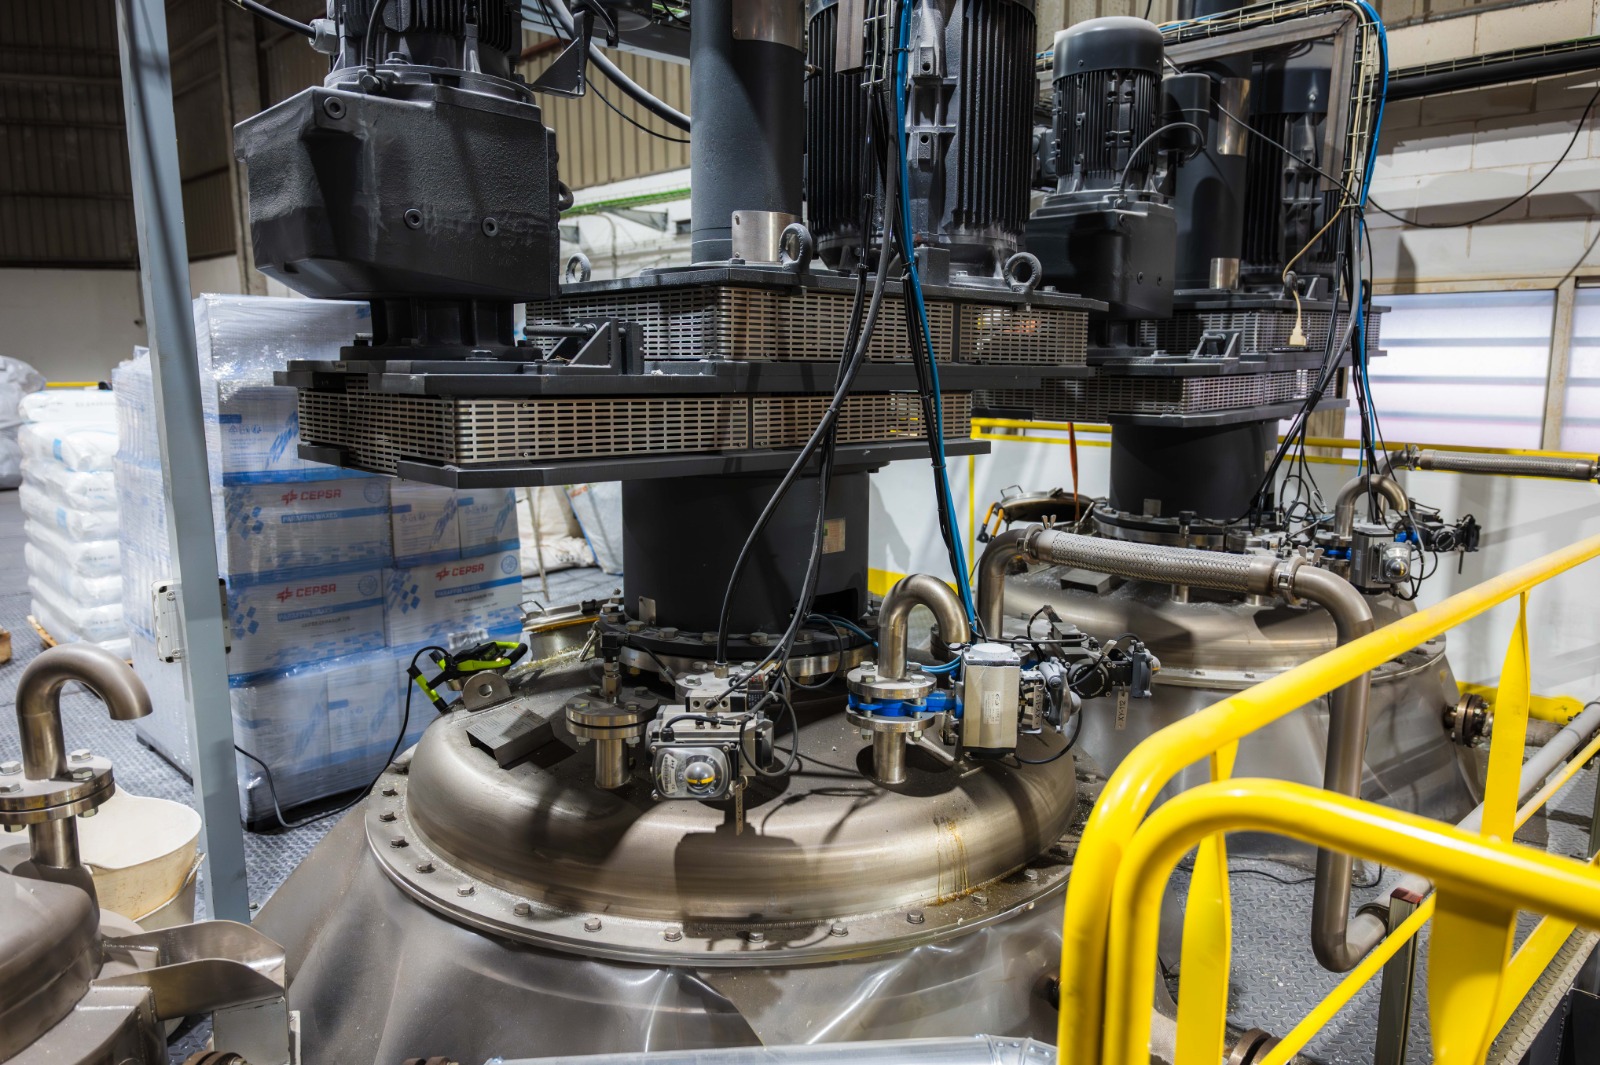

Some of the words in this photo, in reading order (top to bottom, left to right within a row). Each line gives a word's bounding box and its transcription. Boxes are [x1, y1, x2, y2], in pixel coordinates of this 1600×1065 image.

[300, 488, 342, 501] CEPSA
[451, 563, 485, 577] CEPSA
[296, 583, 337, 598] CEPSA
